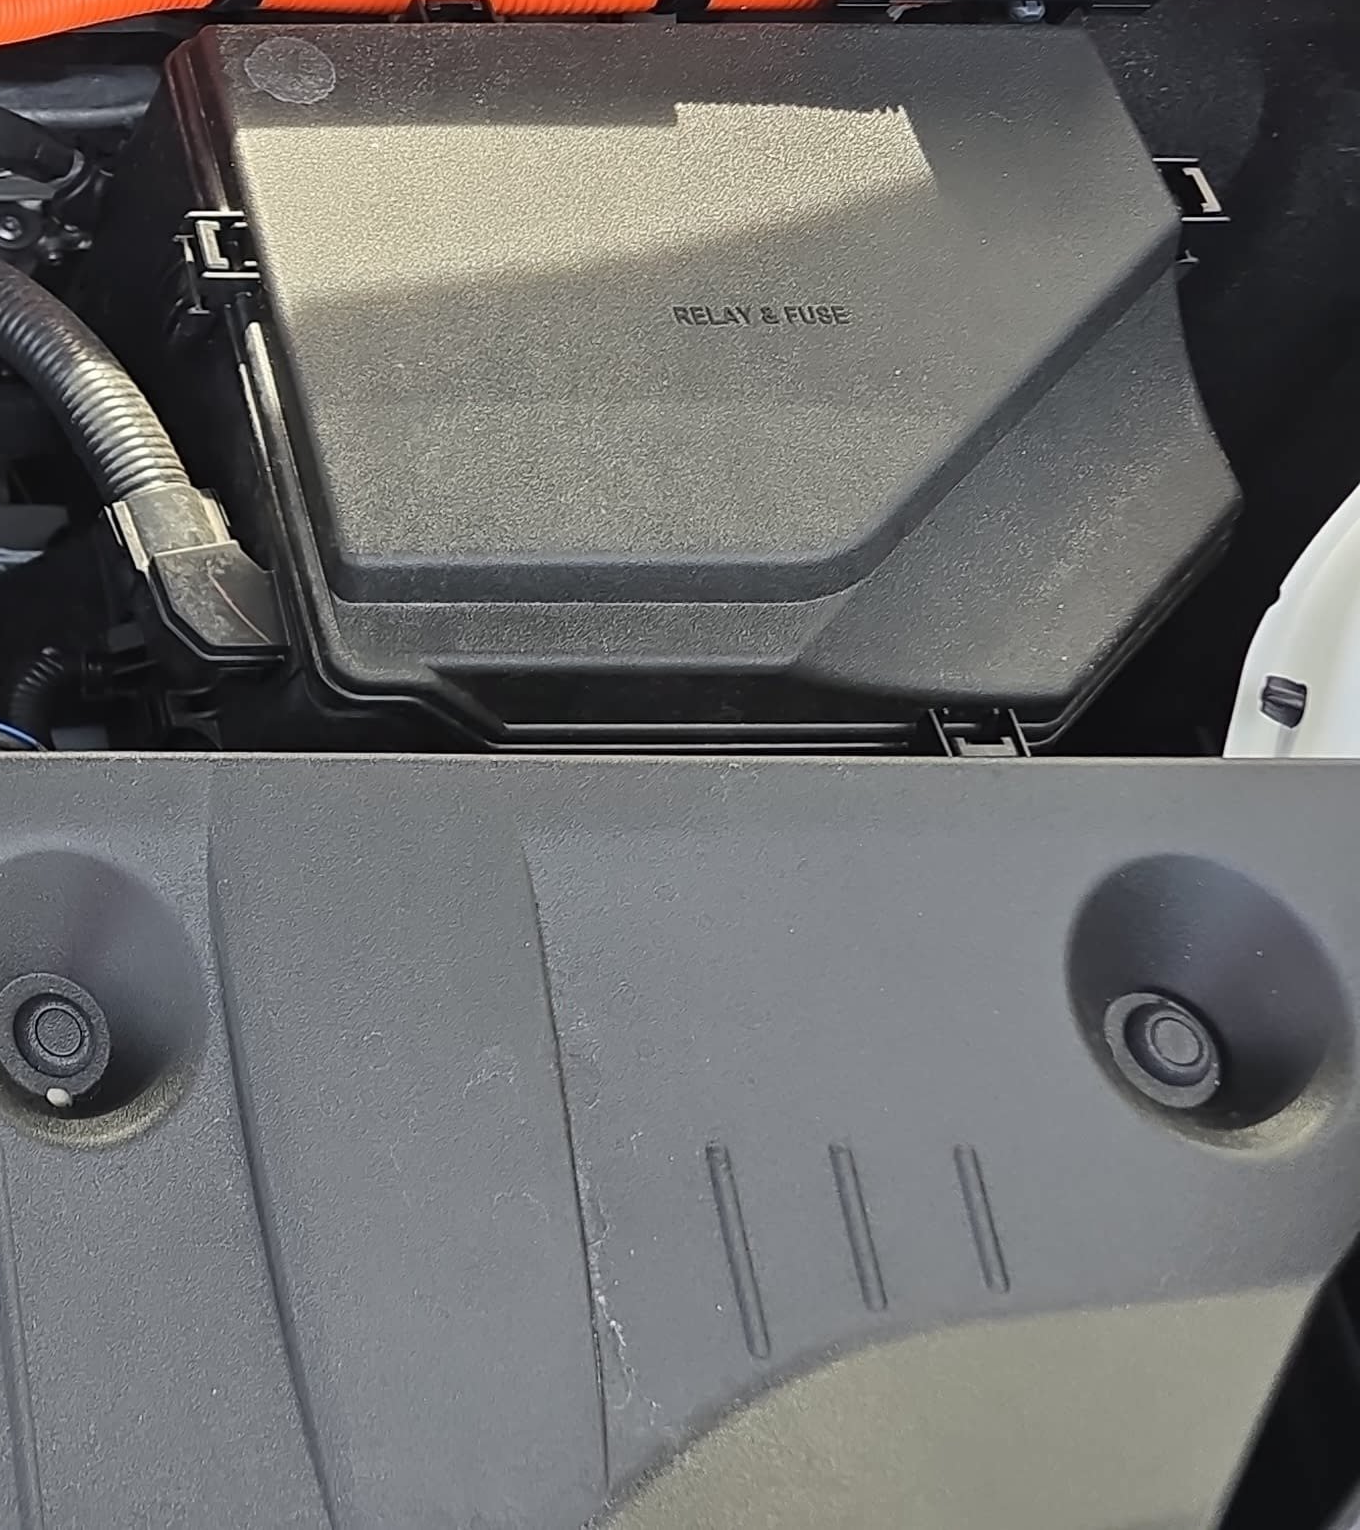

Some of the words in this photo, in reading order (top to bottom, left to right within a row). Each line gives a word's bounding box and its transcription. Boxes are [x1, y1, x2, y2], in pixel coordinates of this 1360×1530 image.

[672, 306, 751, 326] RELAY
[760, 306, 780, 325] &
[784, 306, 852, 326] FUSE
